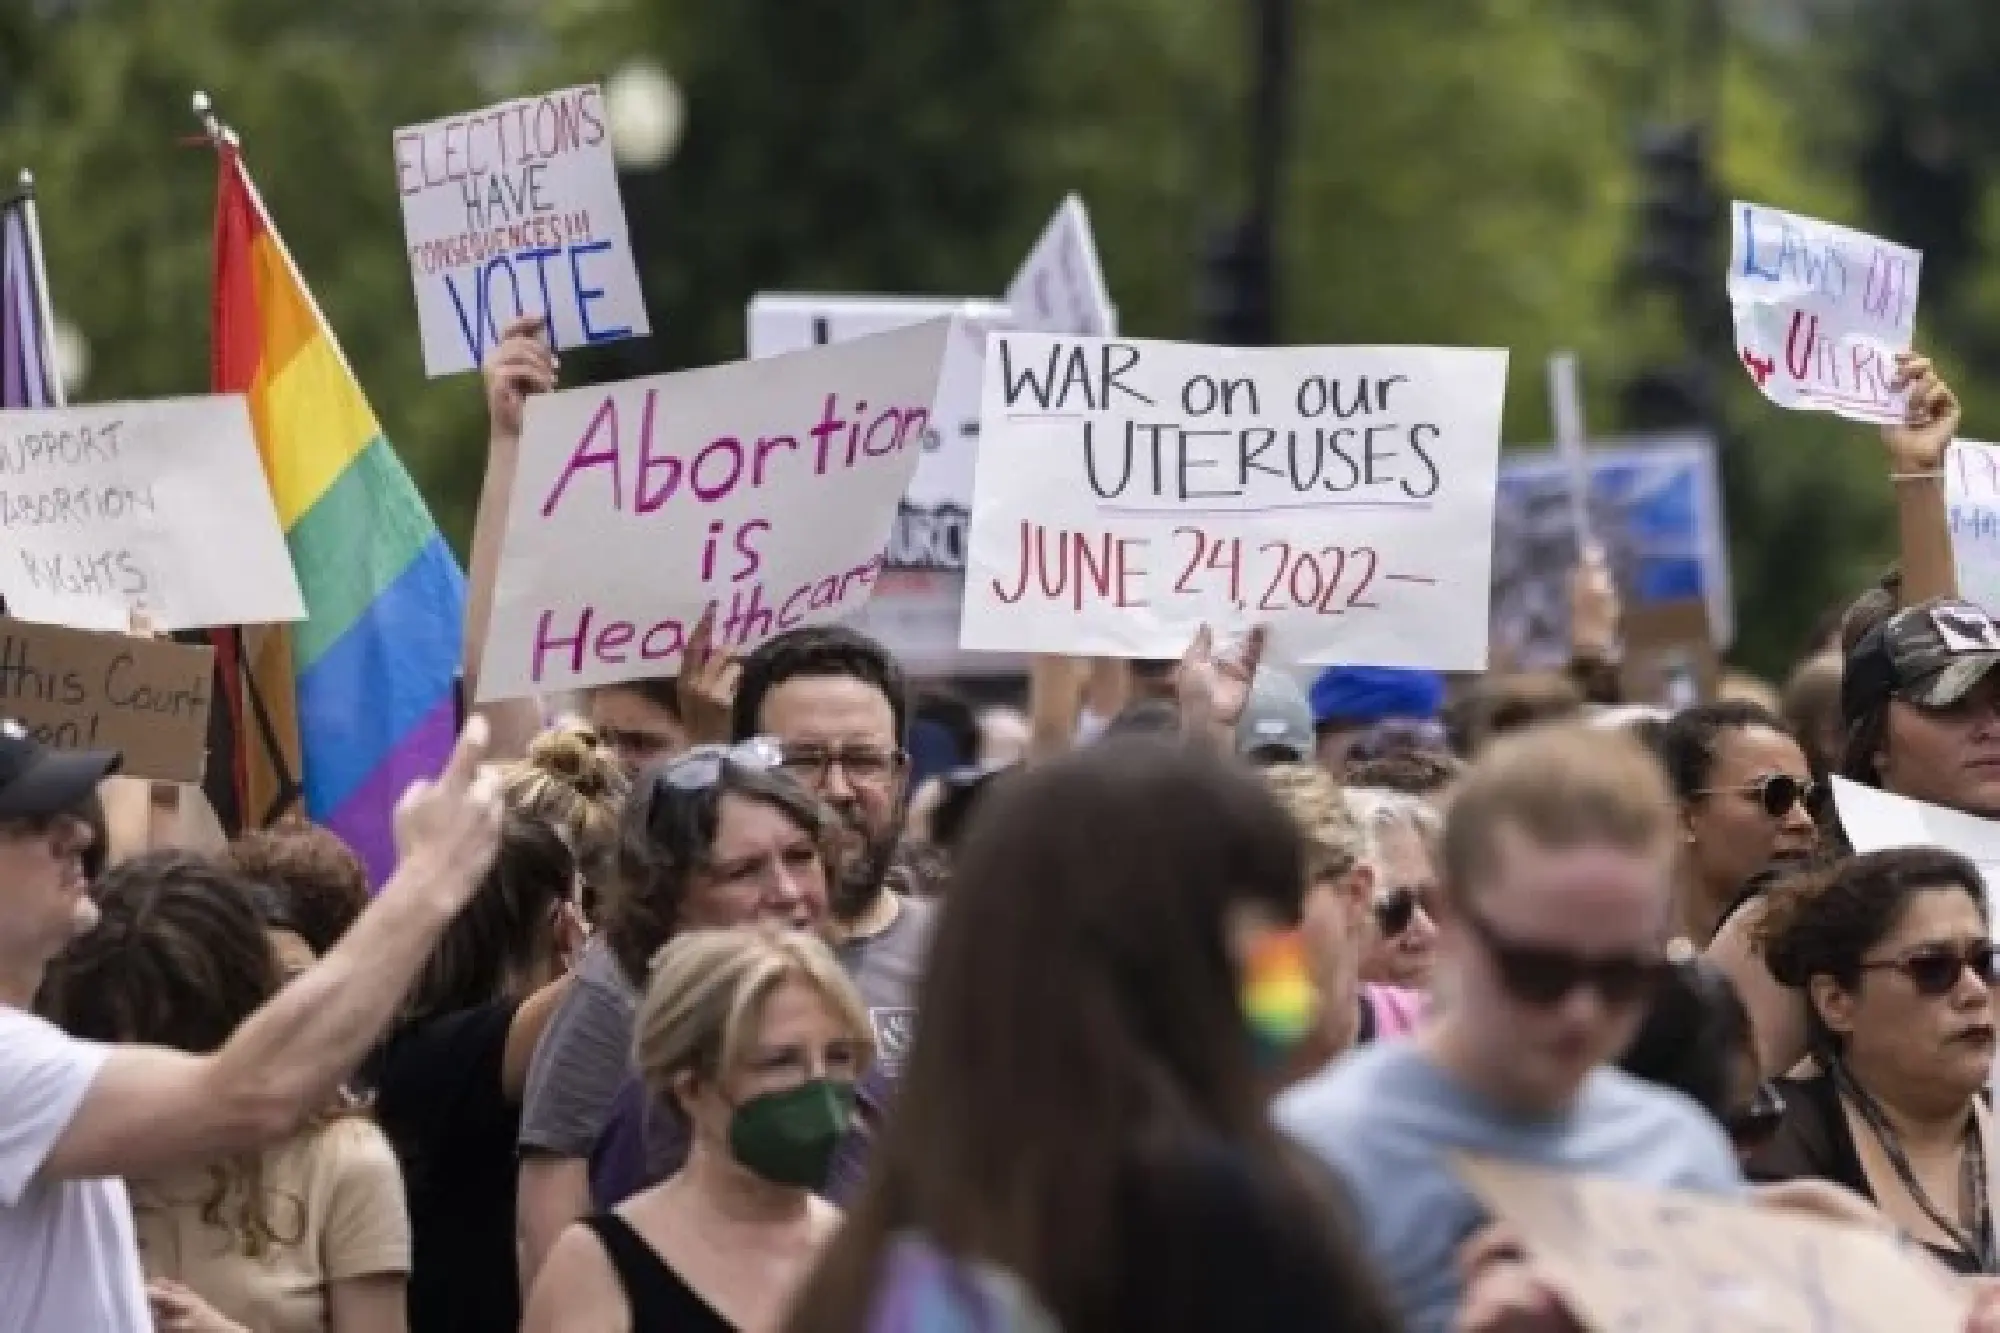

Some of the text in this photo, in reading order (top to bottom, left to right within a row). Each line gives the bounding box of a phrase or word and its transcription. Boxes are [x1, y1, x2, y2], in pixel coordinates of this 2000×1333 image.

[395, 87, 605, 196] ELECTIONS
[461, 163, 555, 230] HAVE
[445, 240, 633, 372] VOTE
[1000, 339, 1410, 418] WAR on our
[540, 388, 930, 517] Abortion
[1083, 420, 1441, 503] UTERUSES
[701, 519, 772, 582] is
[992, 518, 1150, 611] JUNE
[104, 653, 208, 717] Court
